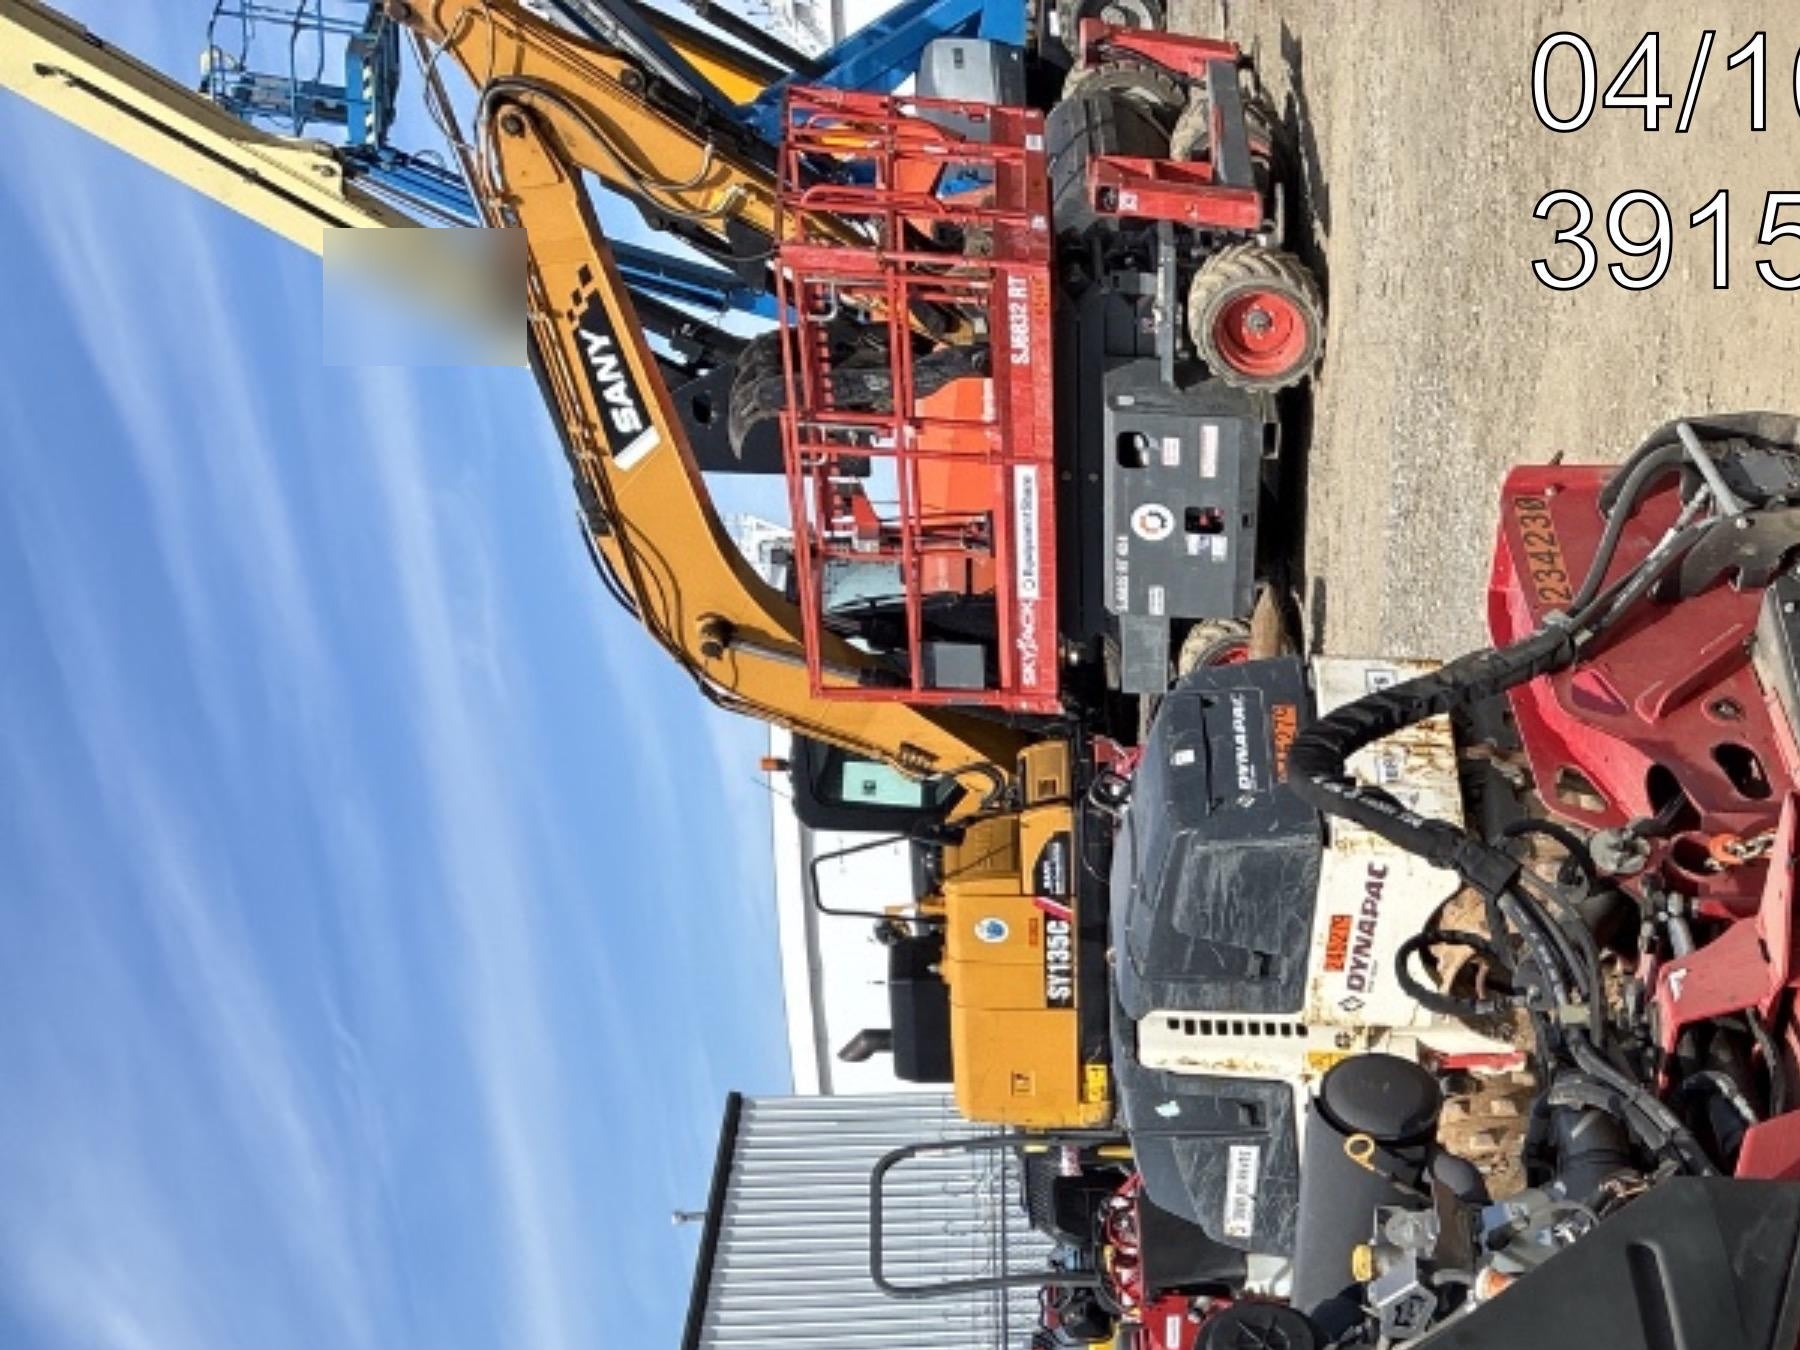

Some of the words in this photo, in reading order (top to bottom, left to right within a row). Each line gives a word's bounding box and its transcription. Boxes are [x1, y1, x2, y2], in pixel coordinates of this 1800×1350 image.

[1007, 275, 1028, 298] RT
[578, 328, 643, 434] SANY
[1514, 496, 1573, 602] 234230
[1046, 920, 1071, 999] SY135C
[1346, 861, 1388, 993] DYNAPAC
